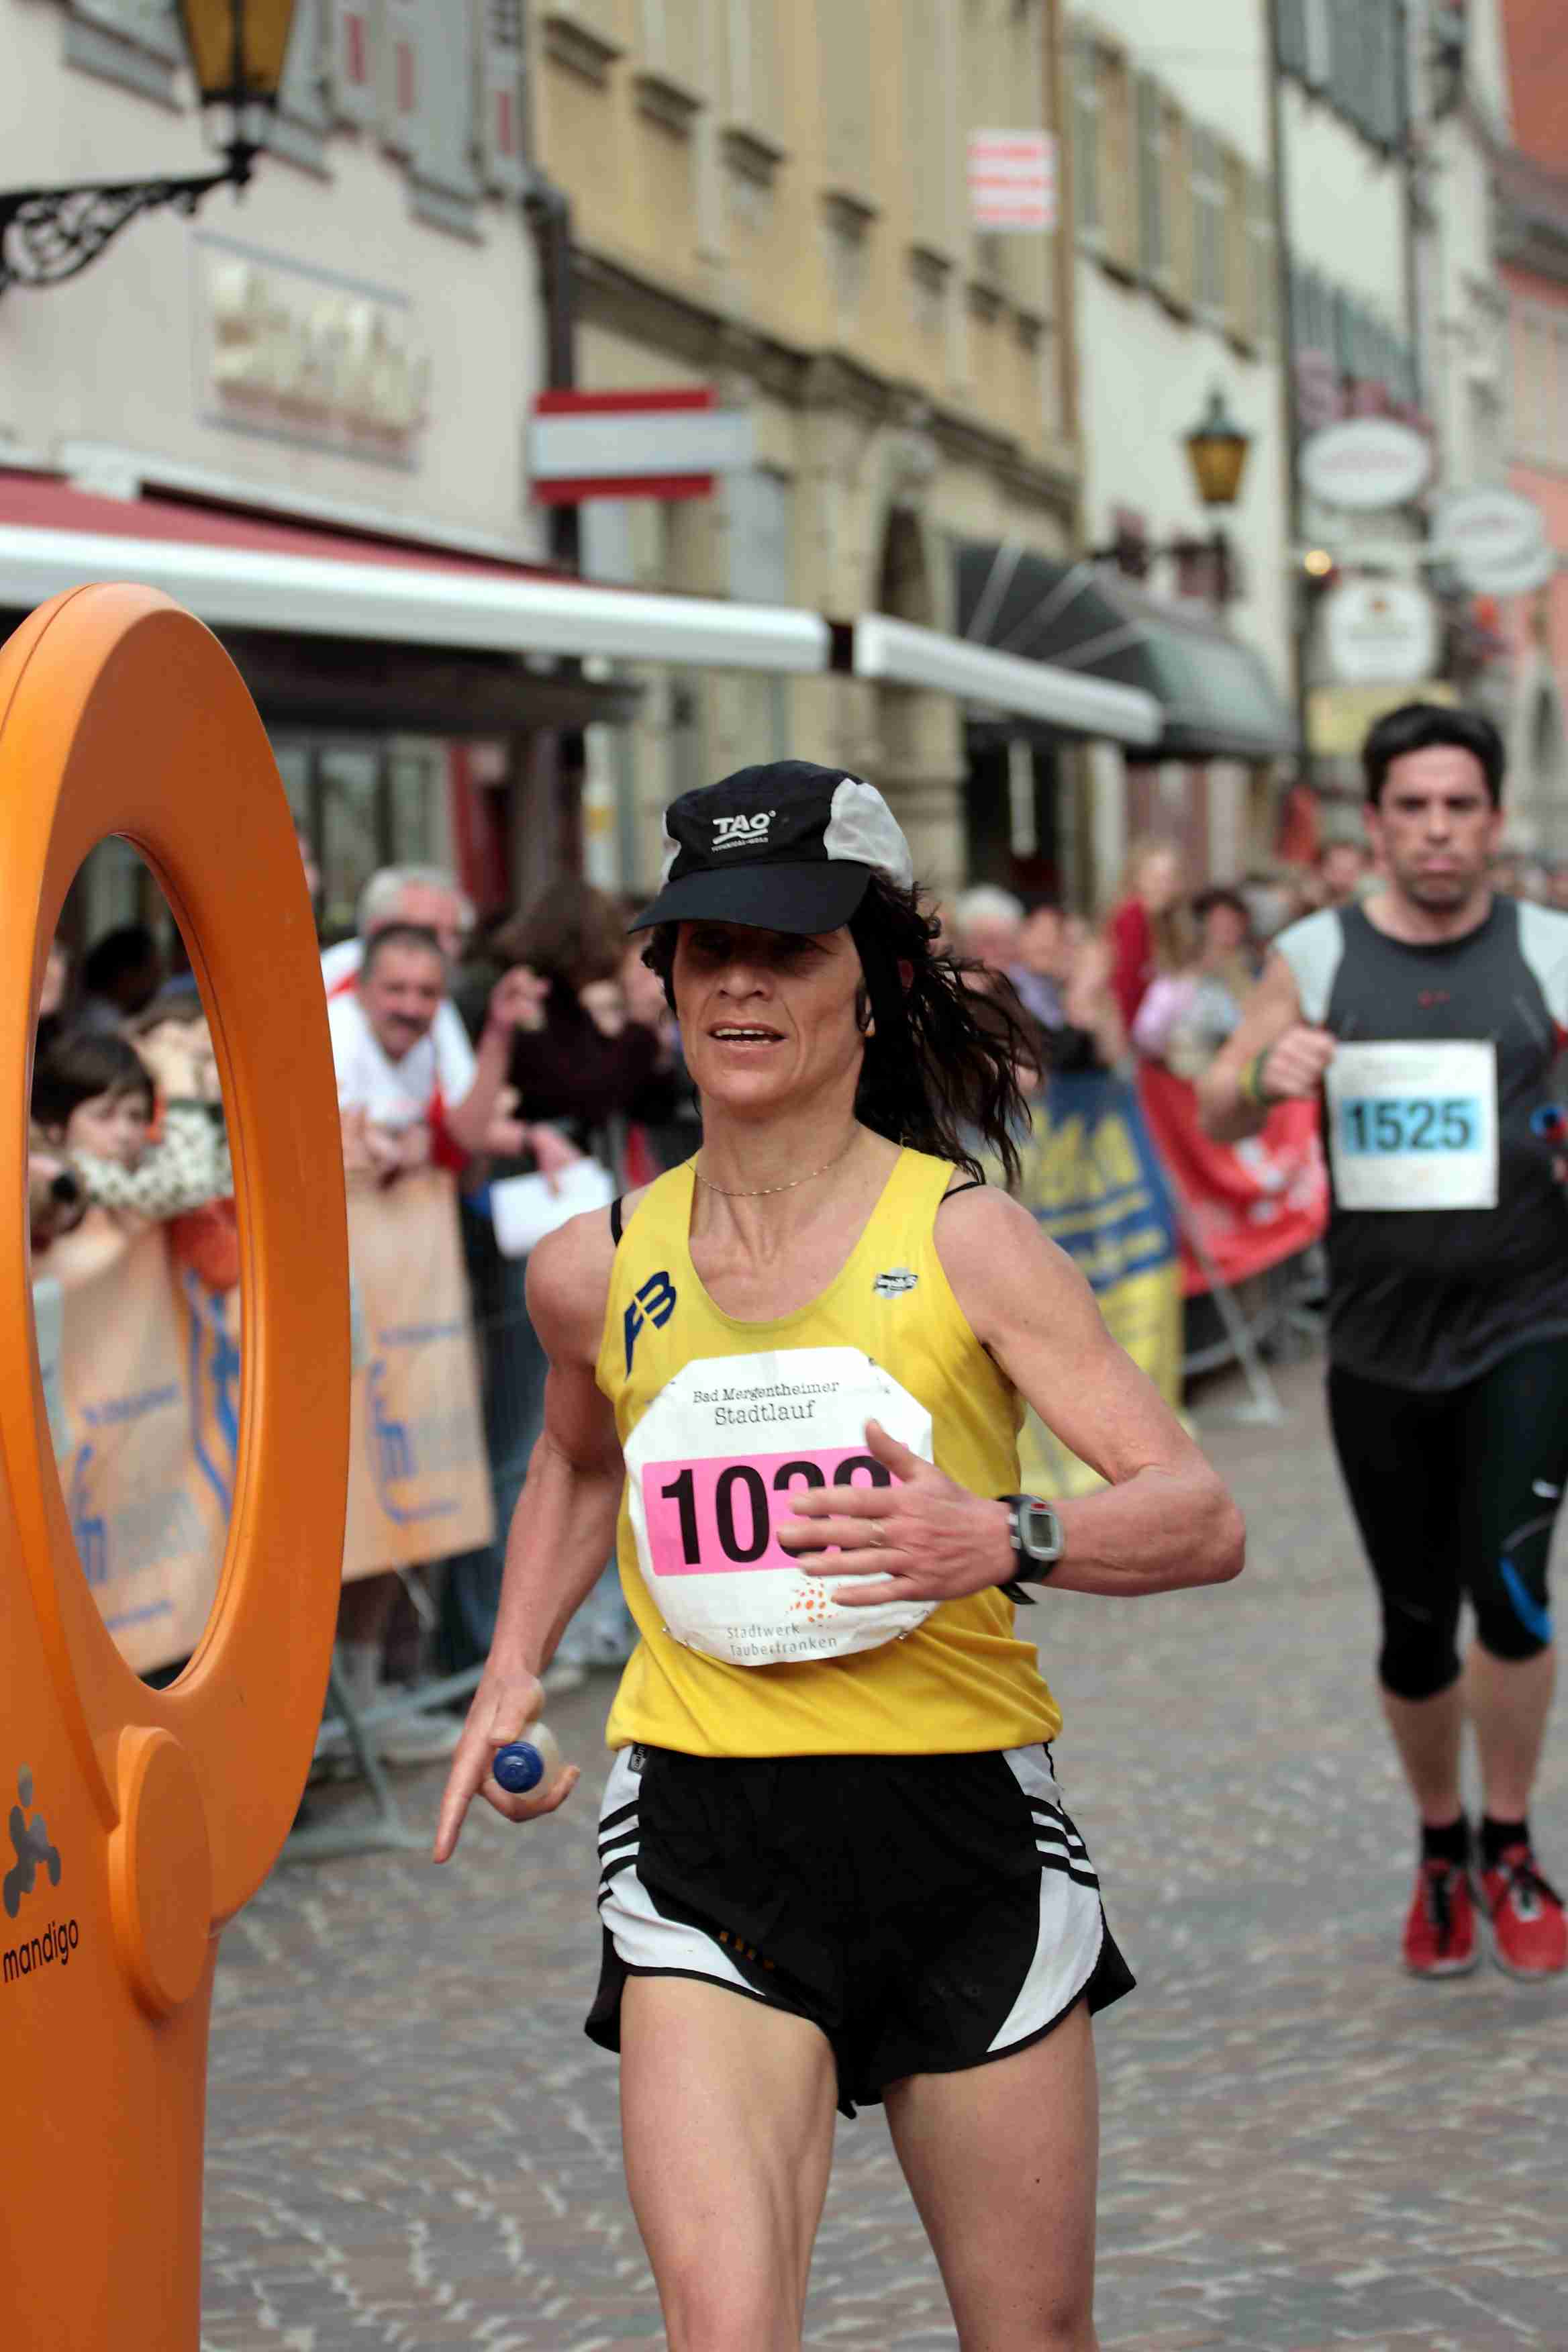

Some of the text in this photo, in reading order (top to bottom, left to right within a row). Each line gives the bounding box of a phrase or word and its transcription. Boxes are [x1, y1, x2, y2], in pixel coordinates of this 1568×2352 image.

[713, 813, 771, 834] TAO
[1347, 1099, 1472, 1152] 1525
[692, 1381, 840, 1403] Bad Mergentheimer
[714, 1400, 816, 1426] Stadtlauf
[727, 1623, 801, 1638] Stadtwerk
[730, 1637, 838, 1656] Tauberfranken
[3, 1919, 79, 1983] mandigo
